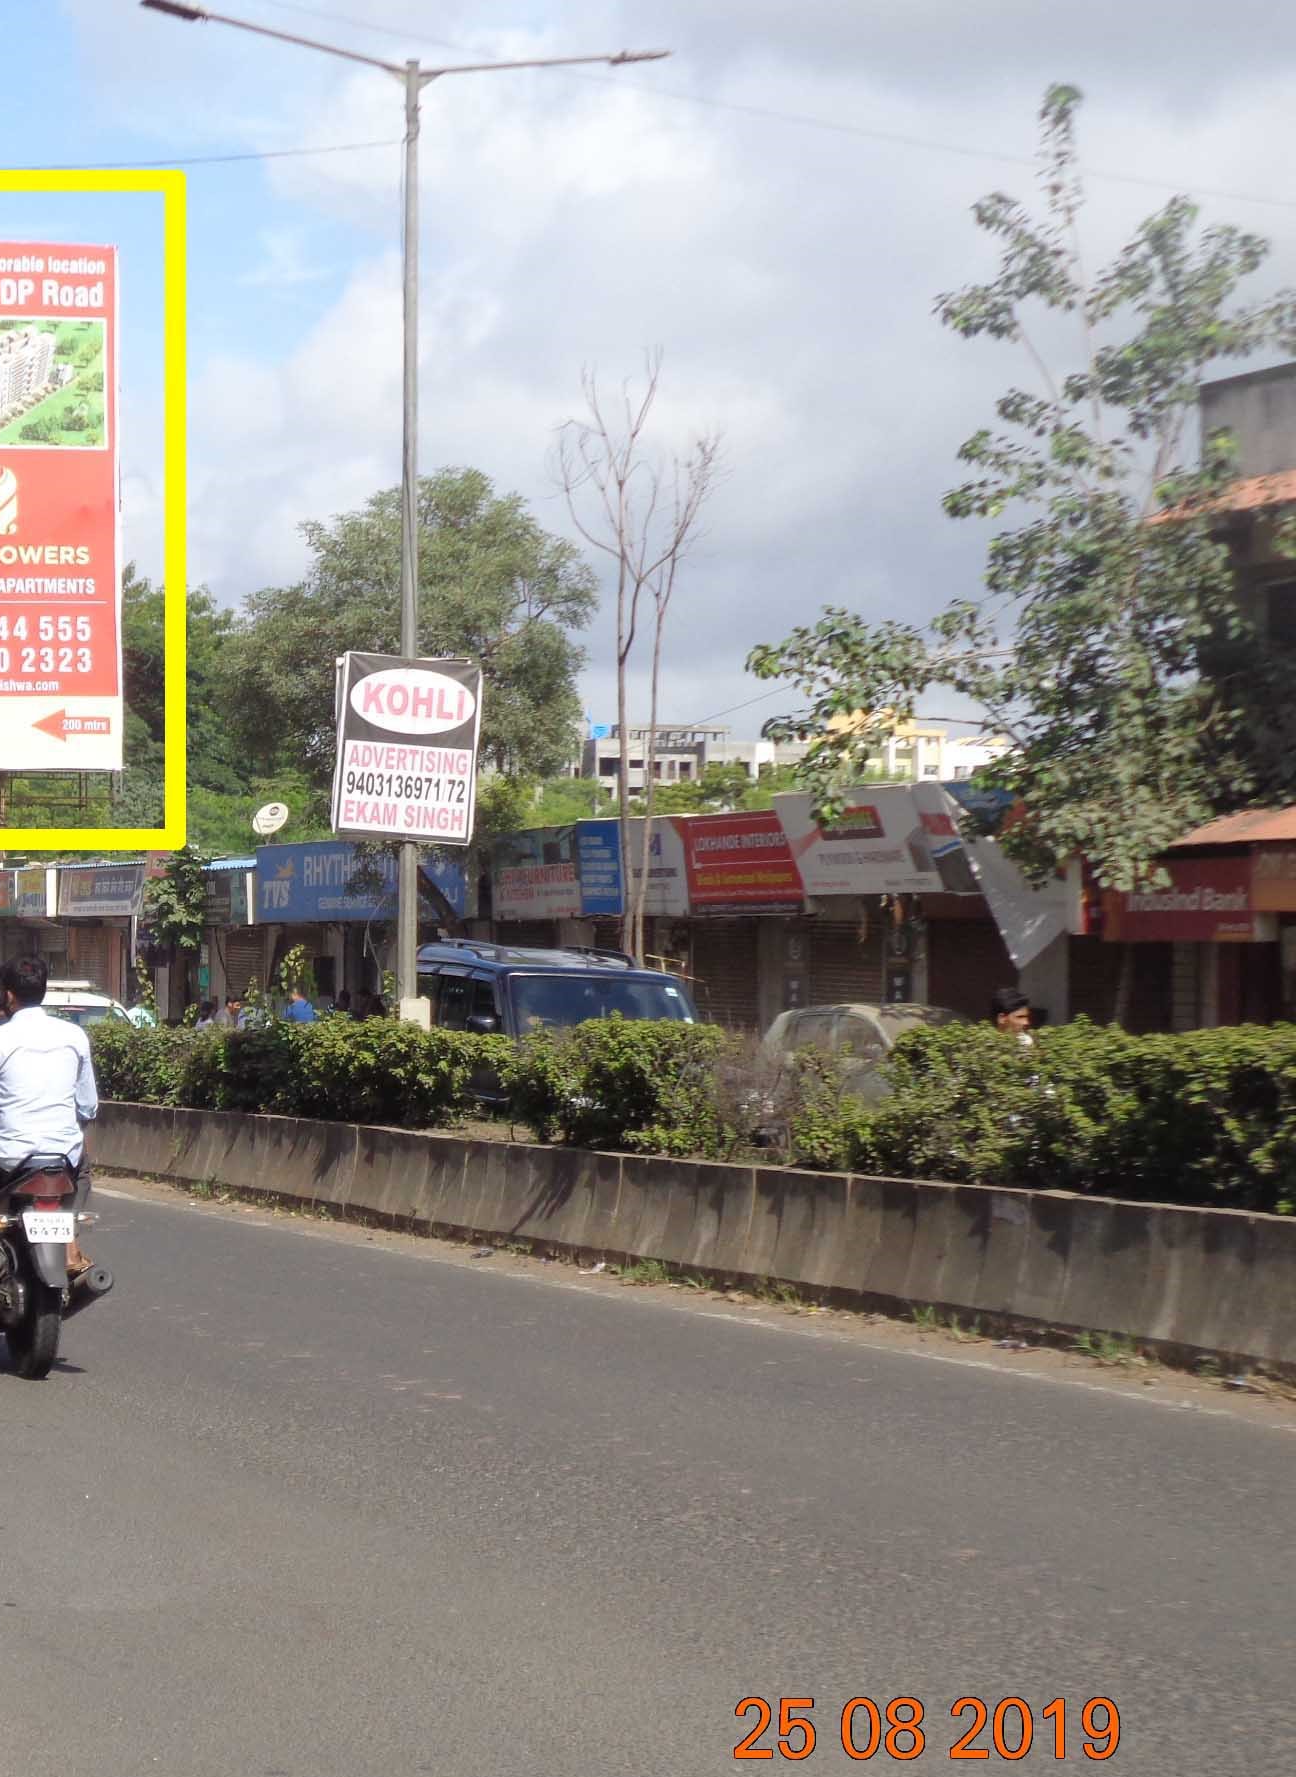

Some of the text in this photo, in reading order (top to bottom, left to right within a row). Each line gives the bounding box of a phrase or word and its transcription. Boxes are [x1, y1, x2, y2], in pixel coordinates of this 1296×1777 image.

[47, 256, 106, 275] location
[0, 279, 35, 306] DP
[42, 279, 105, 308] Road
[39, 616, 92, 641] 555
[21, 647, 92, 673] 2323
[362, 680, 467, 721] KOHLI
[62, 719, 107, 731] 200 mtrs
[347, 745, 468, 776] ADVERTISING
[343, 799, 464, 832] EKAM SINGH
[263, 879, 291, 909] TVS
